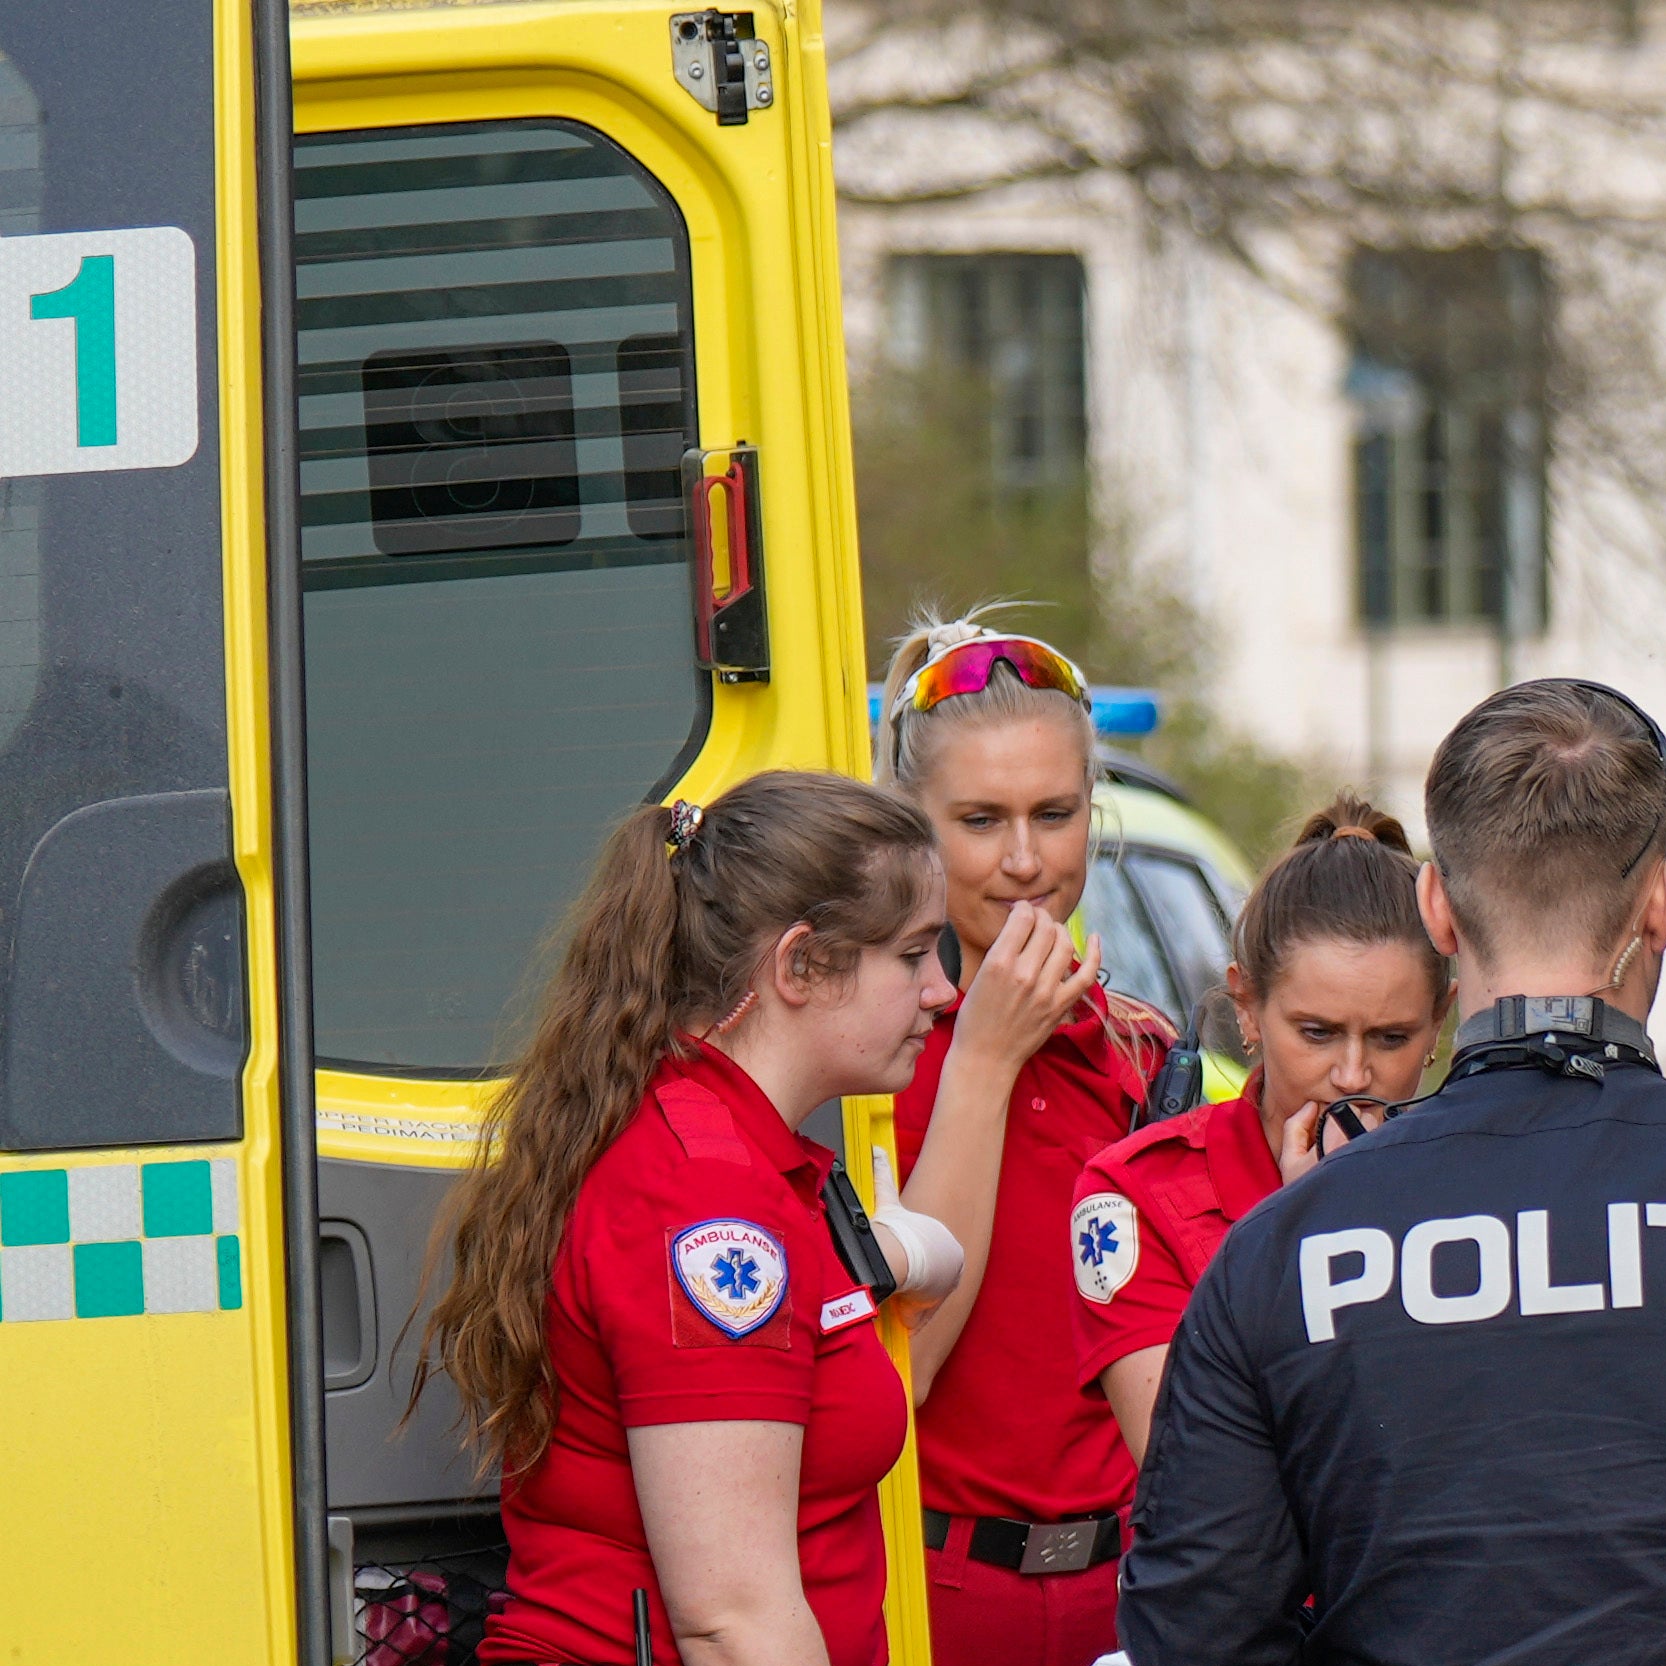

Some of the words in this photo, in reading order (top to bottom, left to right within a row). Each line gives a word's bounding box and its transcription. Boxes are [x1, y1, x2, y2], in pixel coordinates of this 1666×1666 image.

[30, 255, 117, 447] 1
[1074, 1200, 1123, 1223] AMBULANSE
[684, 1231, 778, 1261] AMBULANSE
